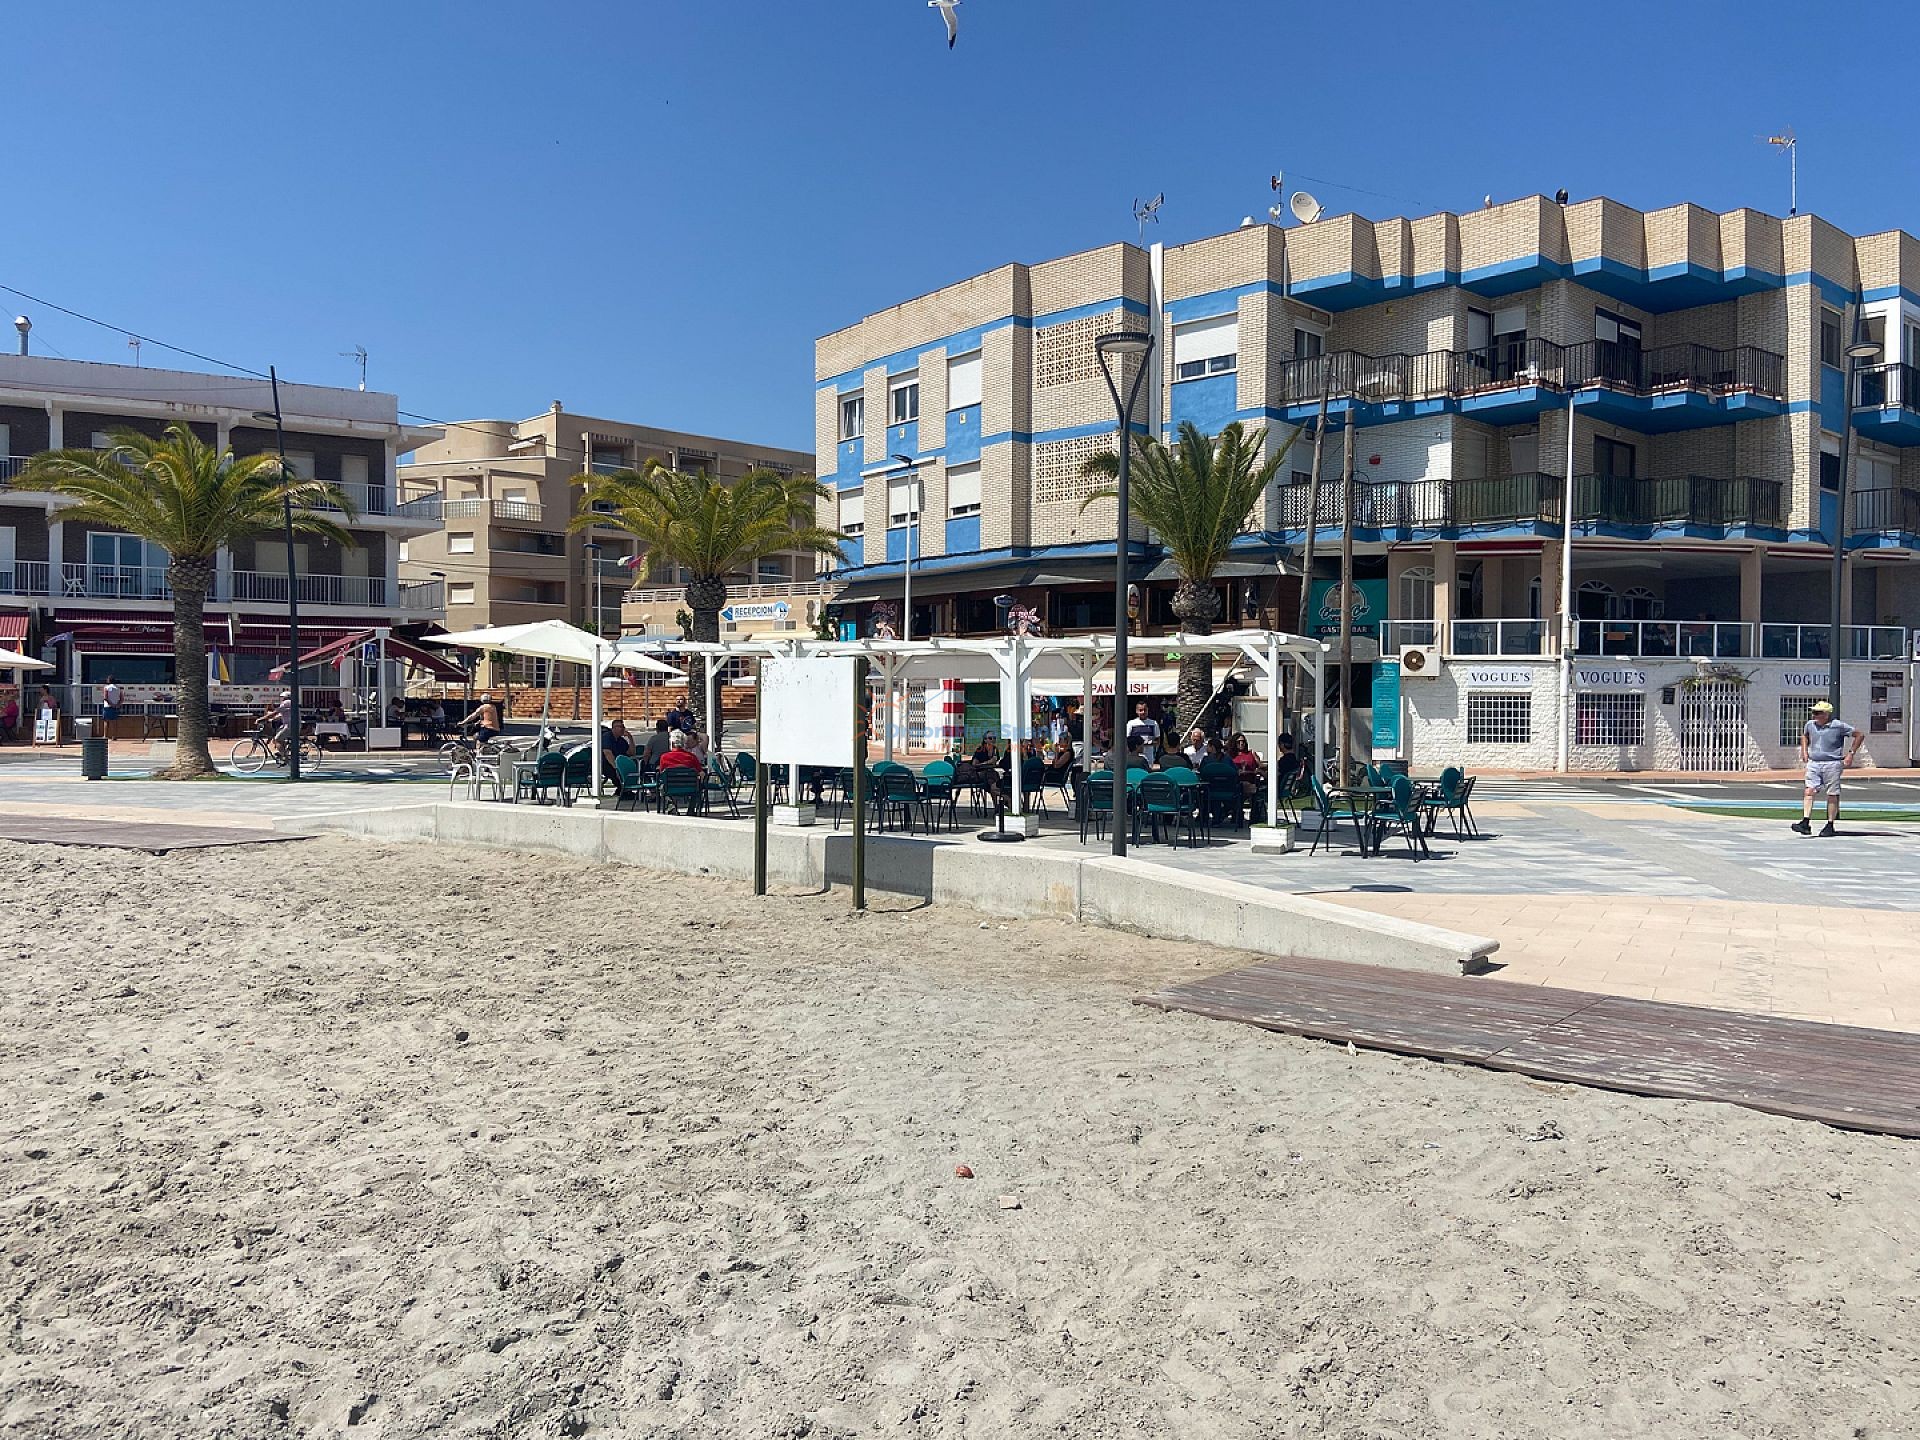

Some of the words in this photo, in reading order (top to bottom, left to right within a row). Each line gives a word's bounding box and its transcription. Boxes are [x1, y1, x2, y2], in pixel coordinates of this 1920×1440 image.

[1471, 672, 1531, 682] VOGUE'S
[1580, 671, 1646, 684] VOGUE'S
[1784, 674, 1831, 686] VOGUE
